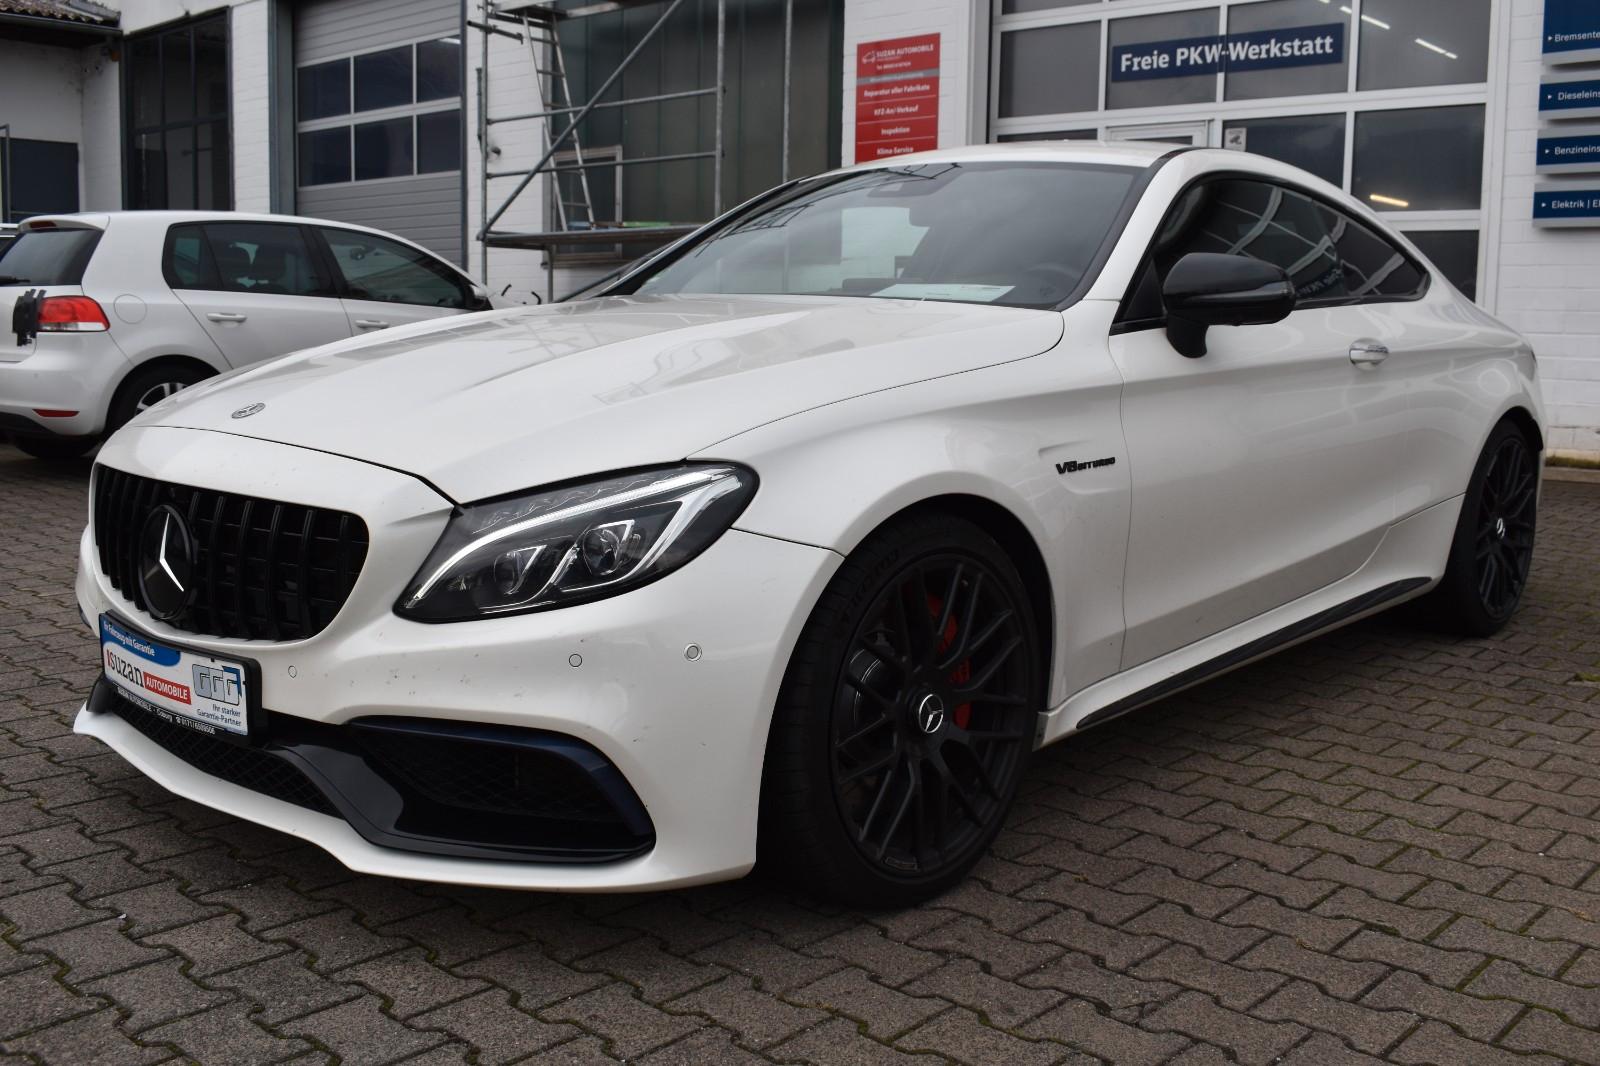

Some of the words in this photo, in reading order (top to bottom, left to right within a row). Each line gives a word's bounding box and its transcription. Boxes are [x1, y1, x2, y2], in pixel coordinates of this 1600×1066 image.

[896, 43, 934, 55] AUTOMOBILE
[1120, 52, 1170, 72] Freie
[1175, 35, 1333, 66] PKW-Werkstatt
[863, 89, 890, 98] Reparatur
[891, 86, 903, 95] aller
[903, 84, 930, 94] Fabrikate
[881, 126, 910, 137] Inspektion
[1551, 199, 1584, 209] Elektrik
[145, 677, 188, 700] AUTOMOBILE
[197, 708, 242, 726] Garantie-Partner
